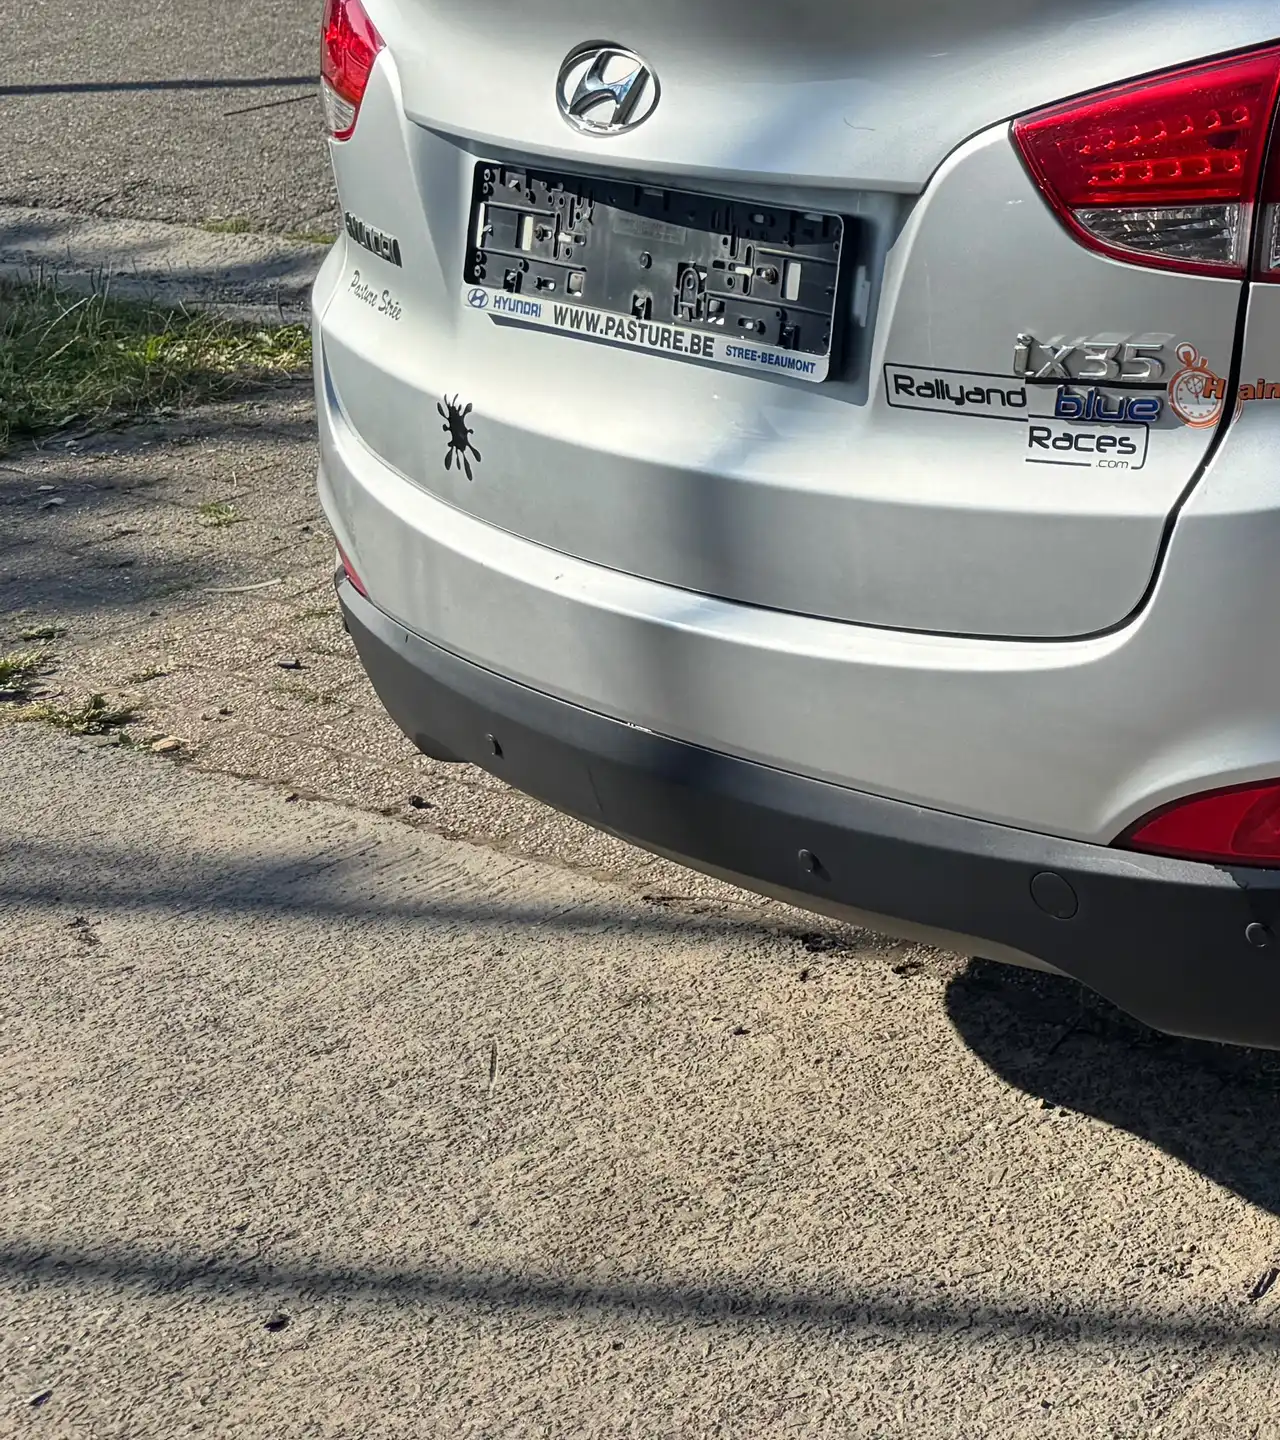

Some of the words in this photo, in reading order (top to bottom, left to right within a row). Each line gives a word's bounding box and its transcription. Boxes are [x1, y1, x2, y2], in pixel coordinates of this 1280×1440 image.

[493, 295, 542, 318] HYUNDAI
[553, 304, 715, 358] WWW.PASTURE.BE
[1054, 384, 1165, 422] blue
[1028, 426, 1137, 455] Races
[1095, 459, 1129, 469] .com
